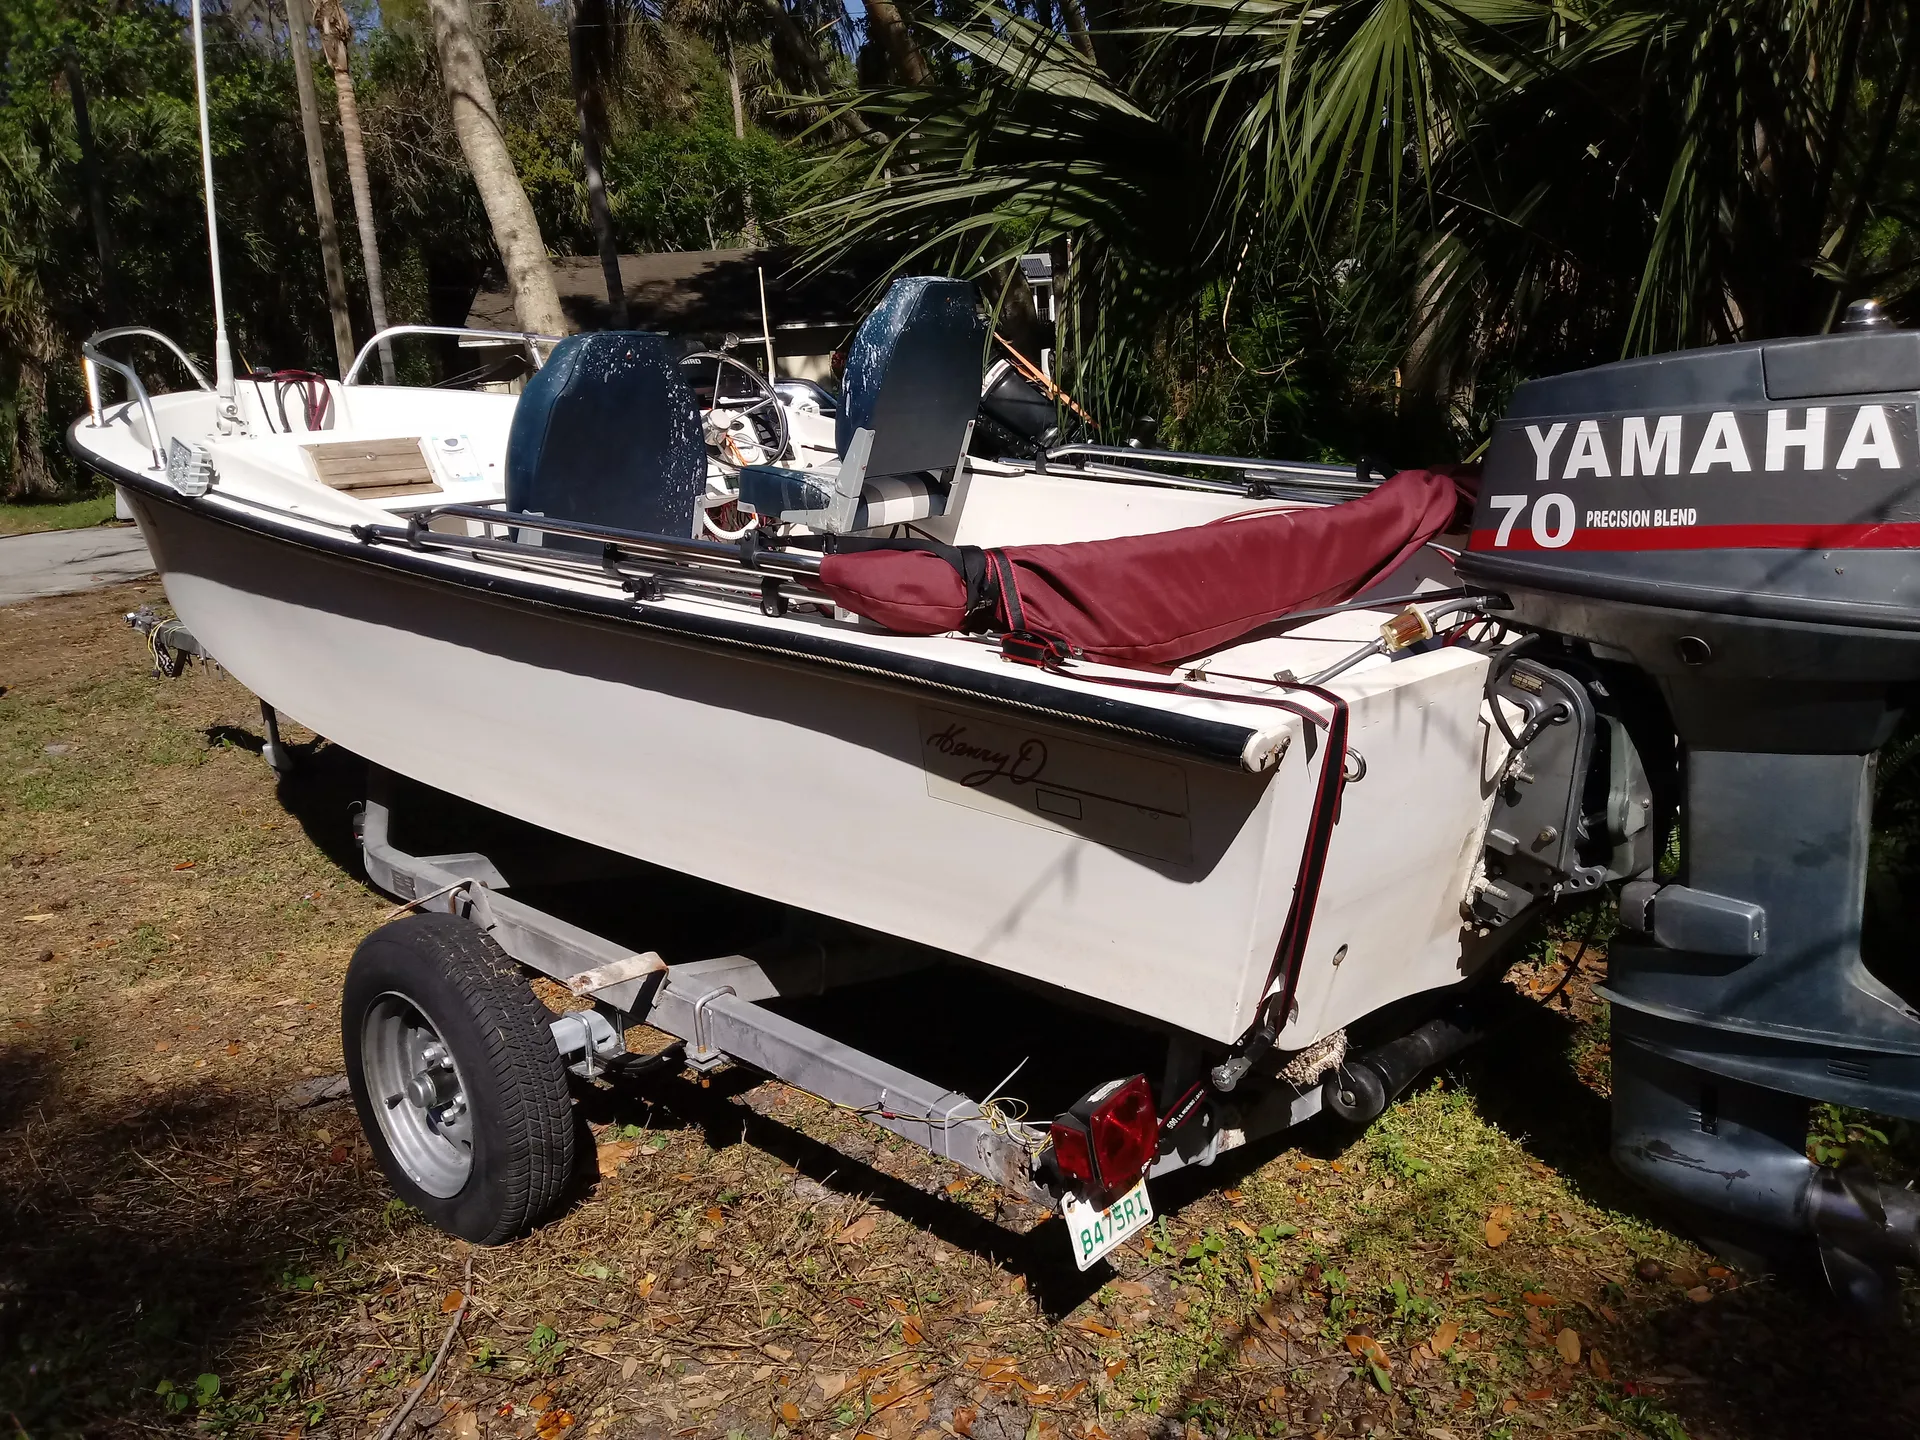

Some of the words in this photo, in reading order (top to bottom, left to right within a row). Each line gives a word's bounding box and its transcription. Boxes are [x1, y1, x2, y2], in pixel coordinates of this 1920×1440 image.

[1525, 405, 1901, 481] YAMAHA
[1490, 493, 1577, 548] 70
[1586, 510, 1650, 528] PRECISION
[1653, 508, 1697, 527] BLEND
[926, 723, 1010, 787] Henry
